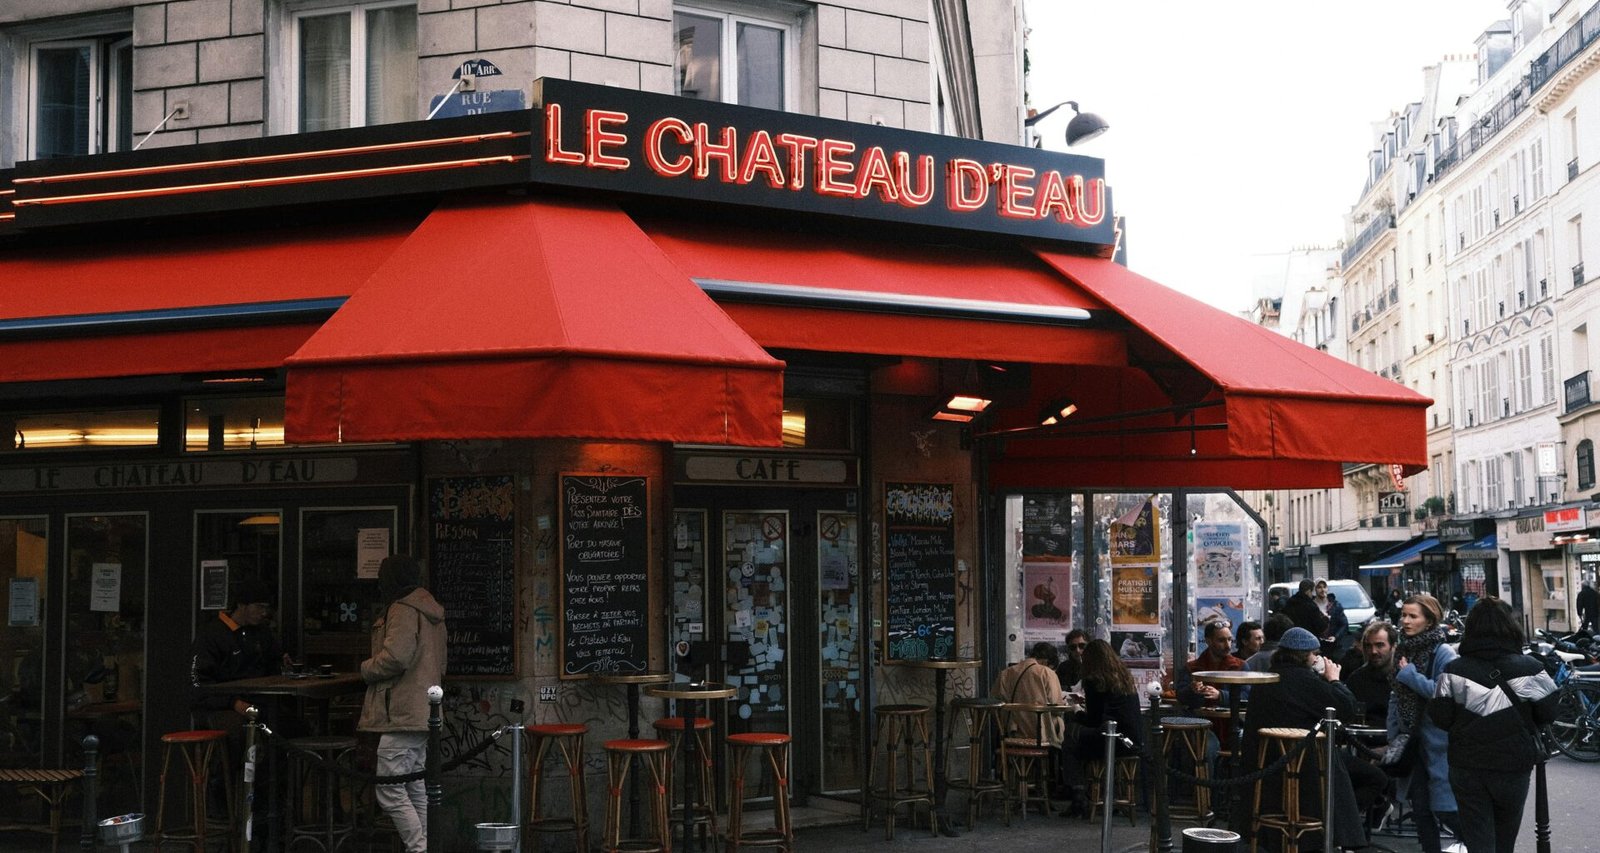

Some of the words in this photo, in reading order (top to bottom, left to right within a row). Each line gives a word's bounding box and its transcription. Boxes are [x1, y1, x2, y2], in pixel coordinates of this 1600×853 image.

[461, 91, 492, 105] RUE
[546, 103, 632, 169] LE
[646, 117, 936, 208] CHATEAU
[946, 158, 1105, 228] D'EAU
[34, 467, 60, 490] LE
[94, 463, 202, 487] CHATEAU
[242, 460, 316, 483] D'EAU
[736, 458, 801, 480] CAFE
[611, 495, 633, 504] VOTRE
[567, 534, 587, 550] PORT
[587, 540, 597, 548] DU
[624, 609, 637, 617] VOS
[541, 693, 556, 701] VPC
